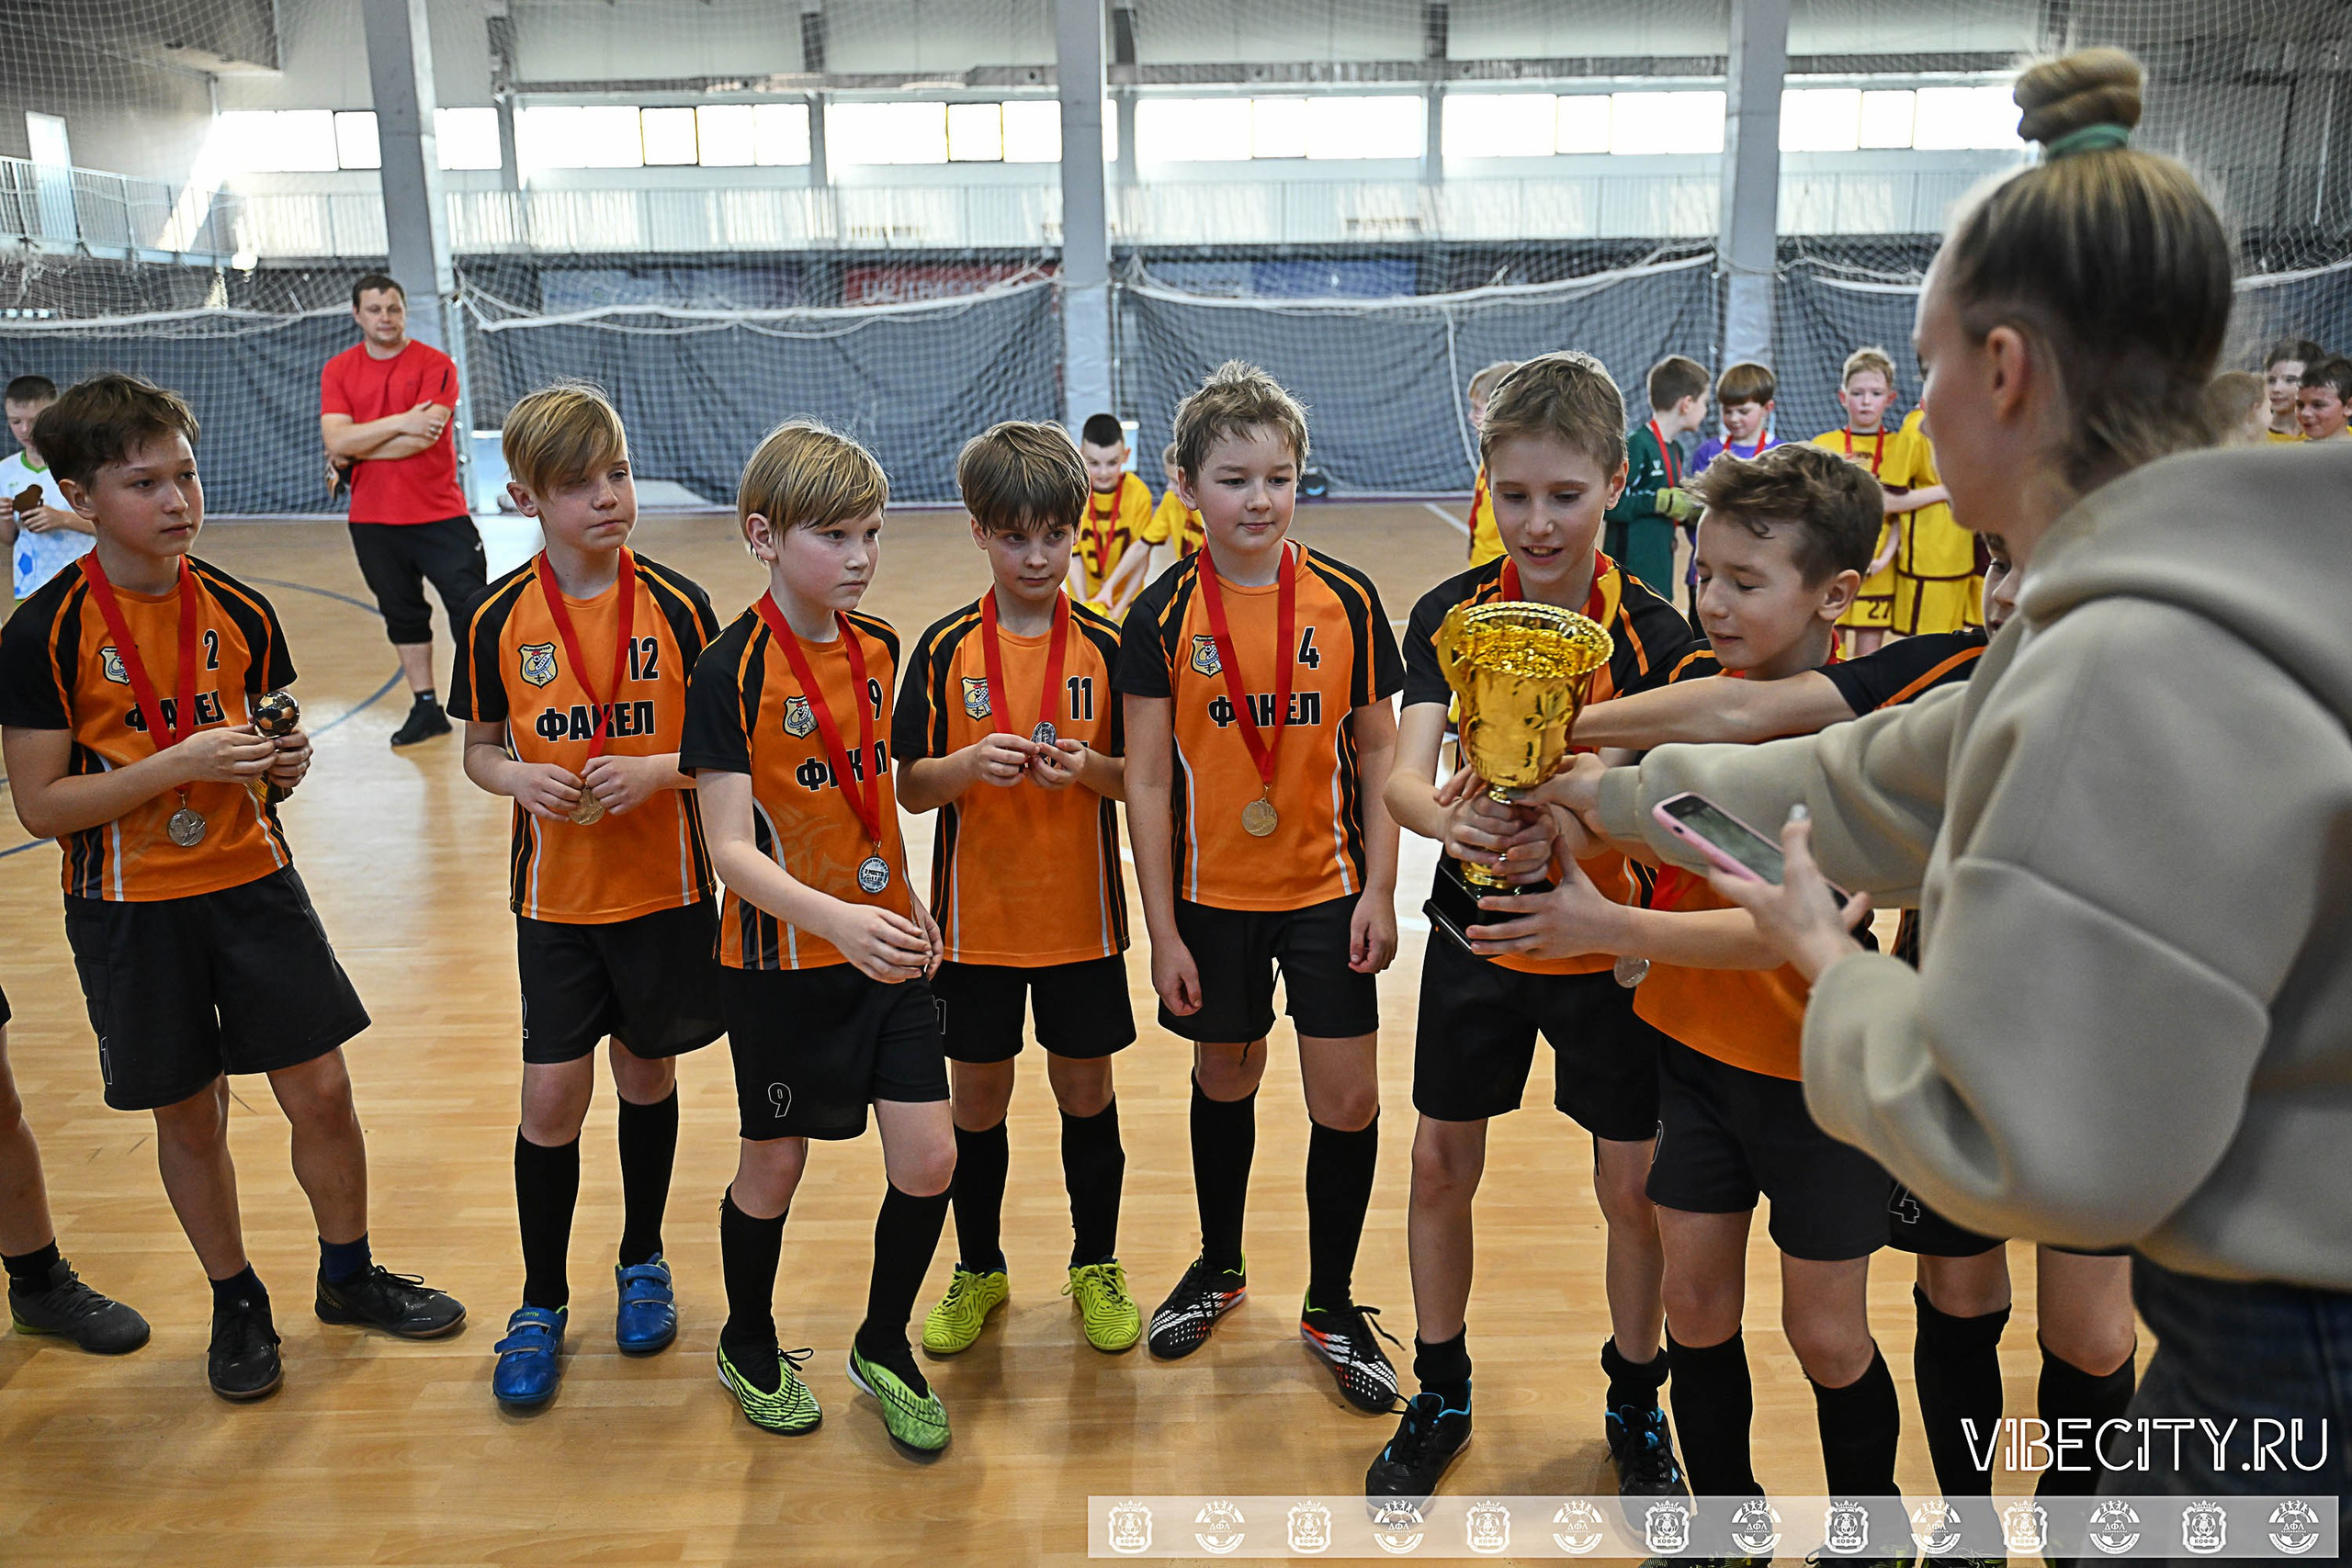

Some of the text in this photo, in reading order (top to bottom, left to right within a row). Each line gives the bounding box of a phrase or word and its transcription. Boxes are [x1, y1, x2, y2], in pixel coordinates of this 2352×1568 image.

[202, 629, 220, 671] 2
[628, 636, 660, 682] 12
[1297, 626, 1321, 671] 4
[124, 689, 227, 732] ФАЕЛ
[866, 677, 883, 720] 9
[1066, 675, 1094, 721] 11
[535, 700, 655, 742] ФАКЕЛ
[795, 739, 888, 792] ФКЛ
[767, 1082, 792, 1118] 9
[1887, 1180, 1920, 1224] 4
